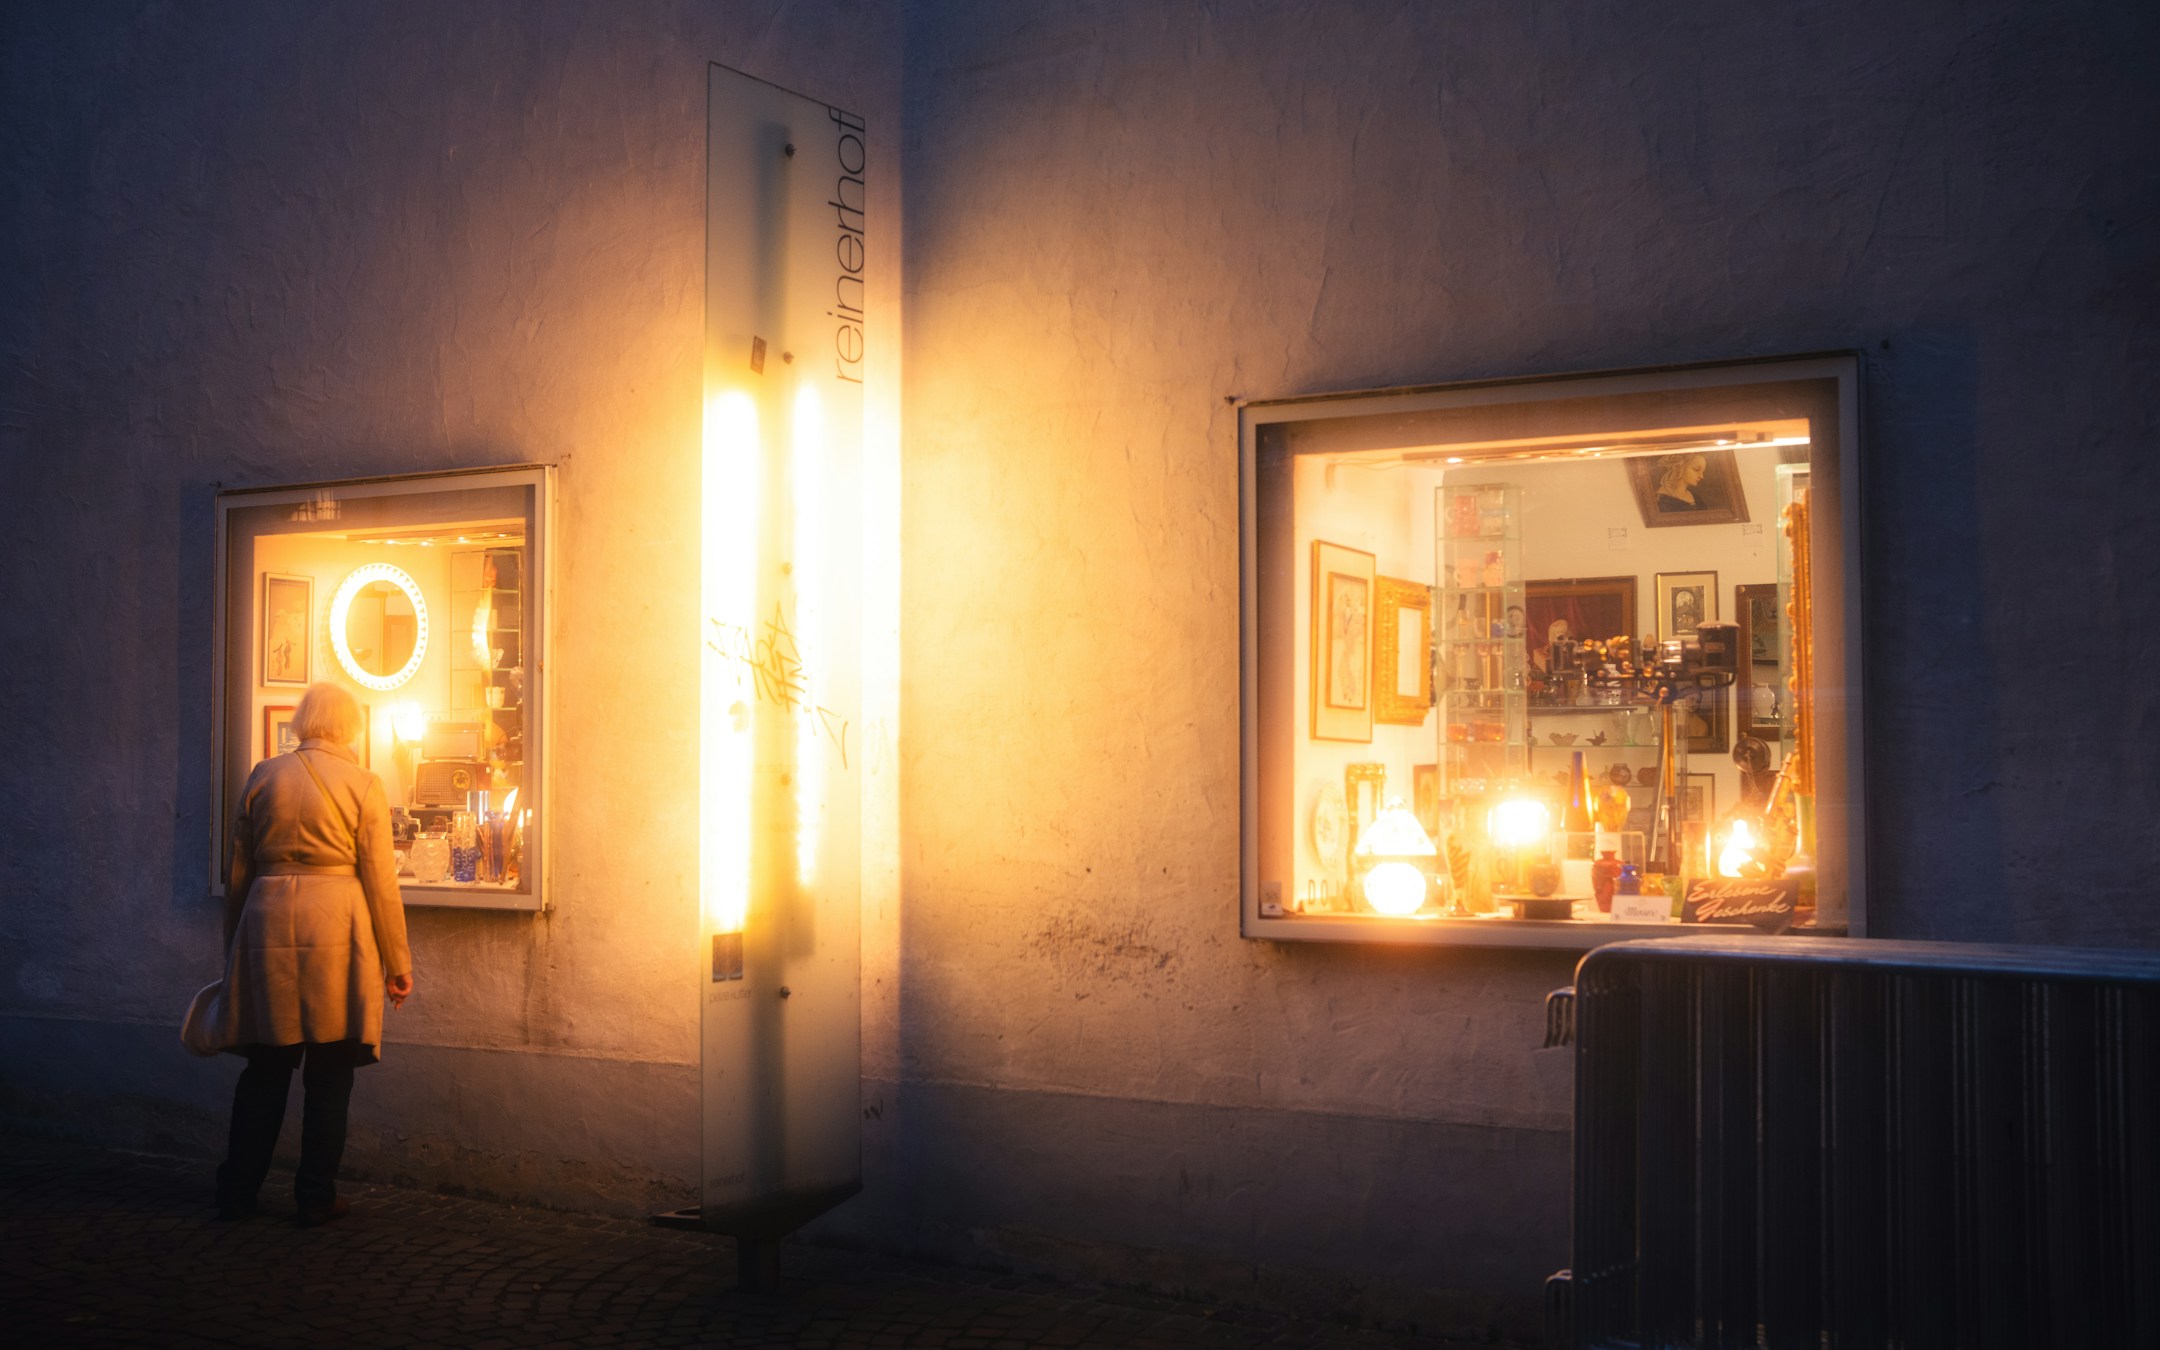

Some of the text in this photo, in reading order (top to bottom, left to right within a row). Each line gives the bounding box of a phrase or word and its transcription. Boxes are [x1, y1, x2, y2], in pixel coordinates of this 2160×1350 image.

[827, 107, 865, 384] reinerhof
[1687, 880, 1777, 902] Erlesene
[1696, 891, 1791, 922] Geschenke
